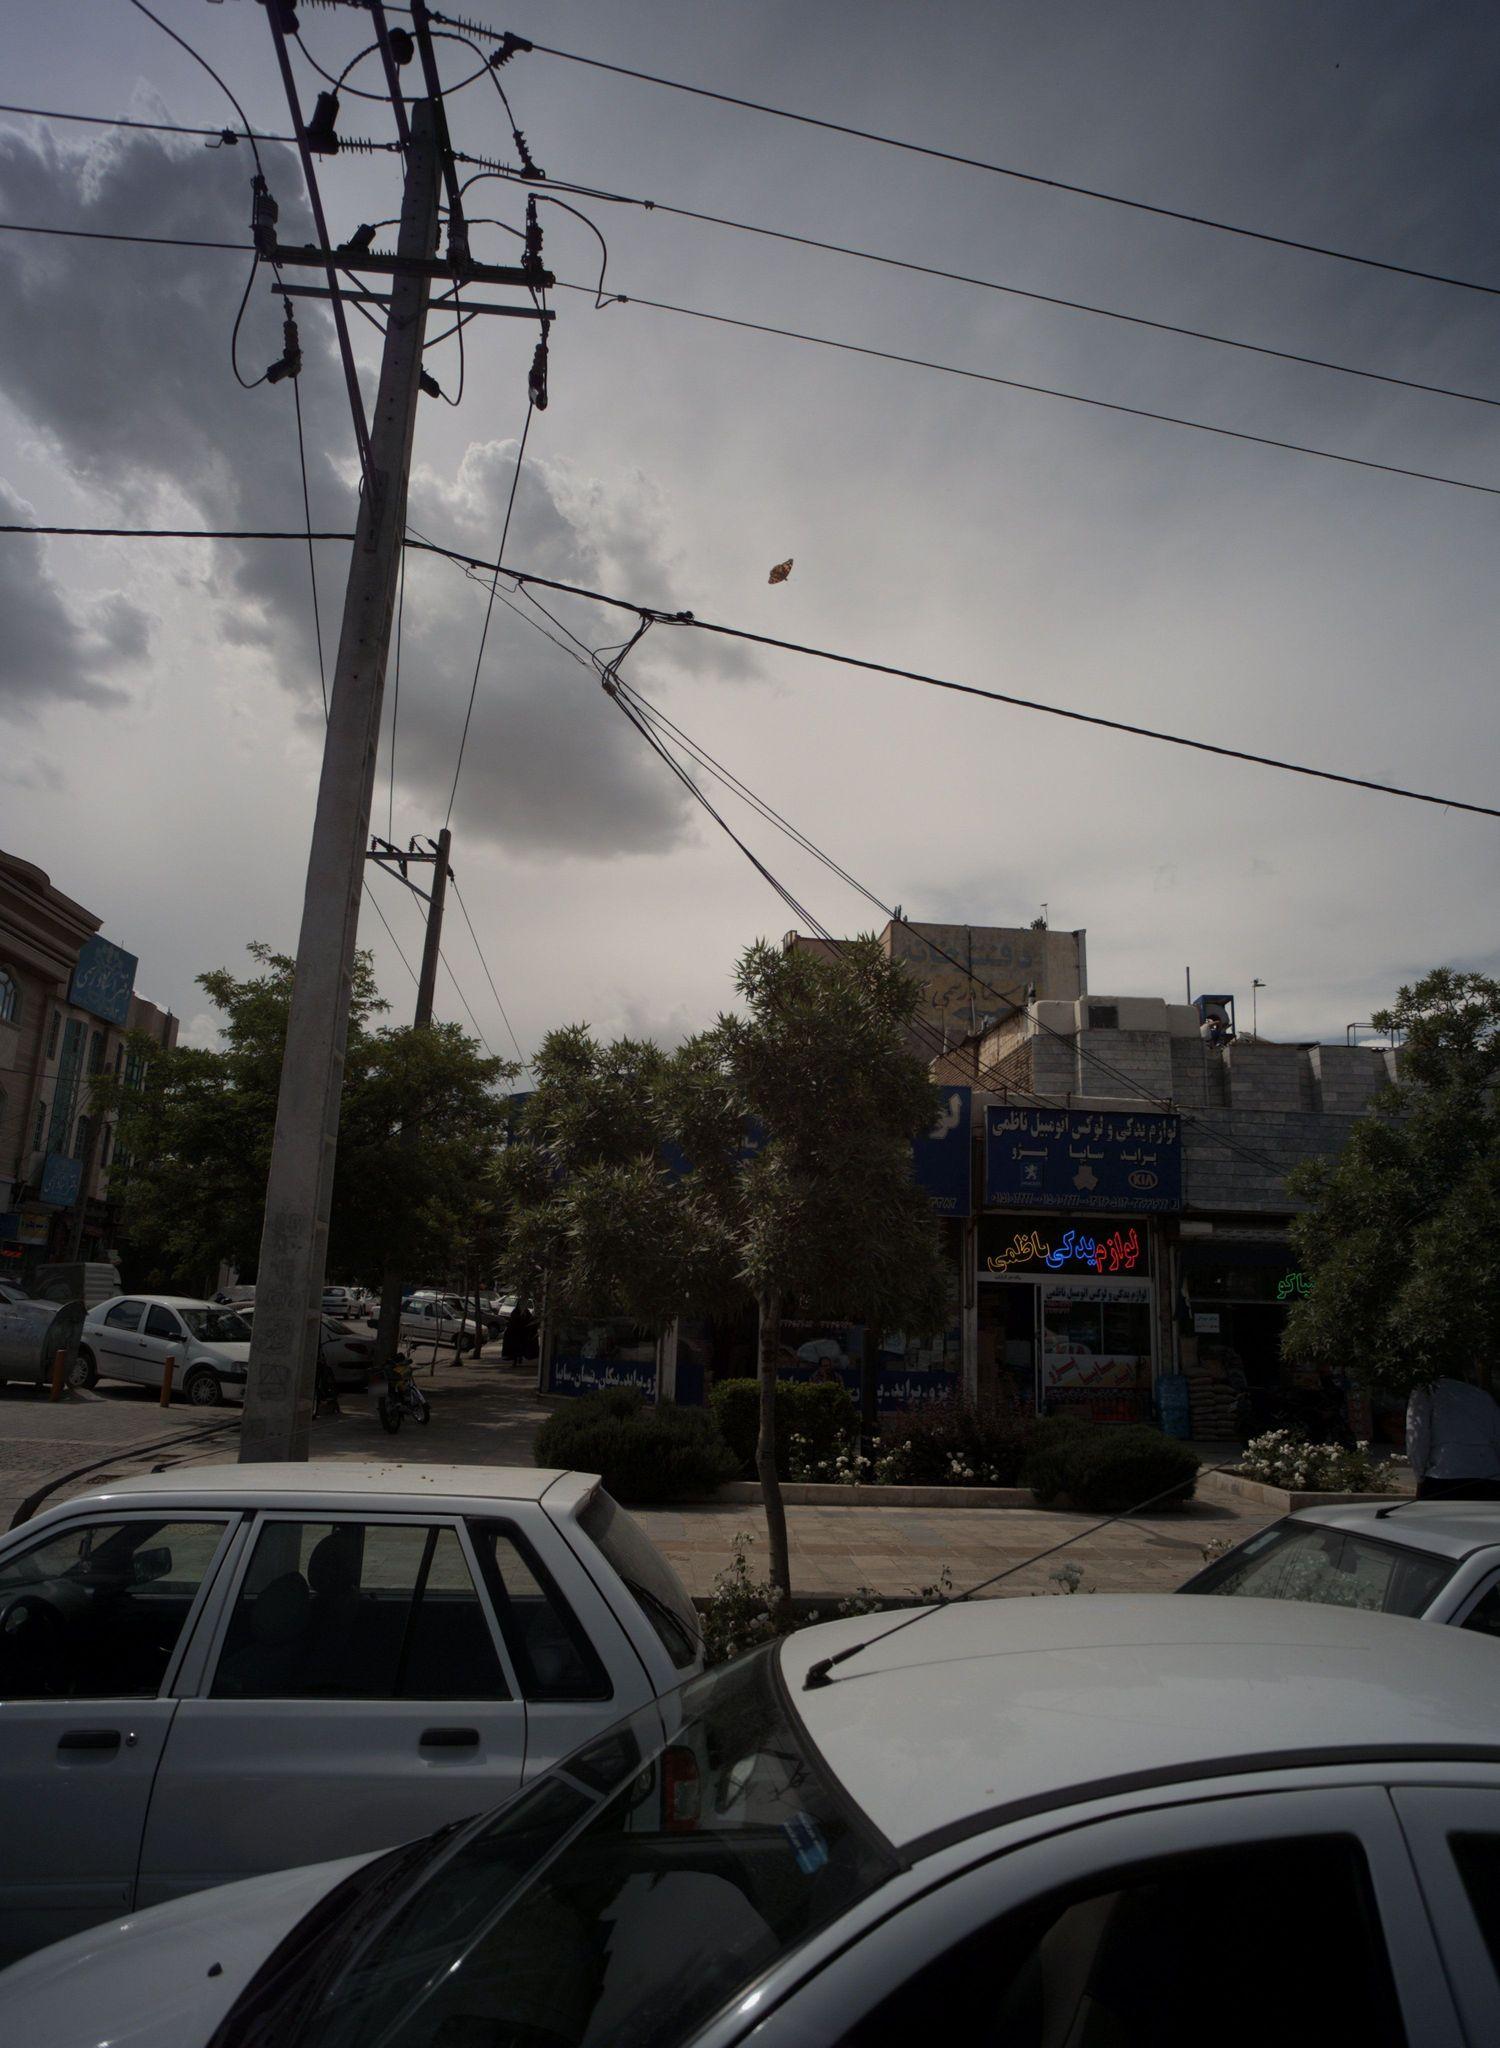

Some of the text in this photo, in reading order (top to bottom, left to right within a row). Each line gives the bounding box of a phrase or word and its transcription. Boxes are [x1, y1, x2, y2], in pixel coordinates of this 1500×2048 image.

[992, 1110, 1028, 1137] ناظمی
[1030, 1112, 1069, 1140] اتومبیل
[1071, 1113, 1104, 1142] لوکس
[1107, 1123, 1113, 1142] و
[1116, 1117, 1145, 1142] یدکی
[1148, 1119, 1177, 1145] لوازم
[1011, 1142, 1158, 1167] پراید سایپا پژو
[1046, 1230, 1096, 1268] یدکی
[1095, 1228, 1139, 1272] لوازم
